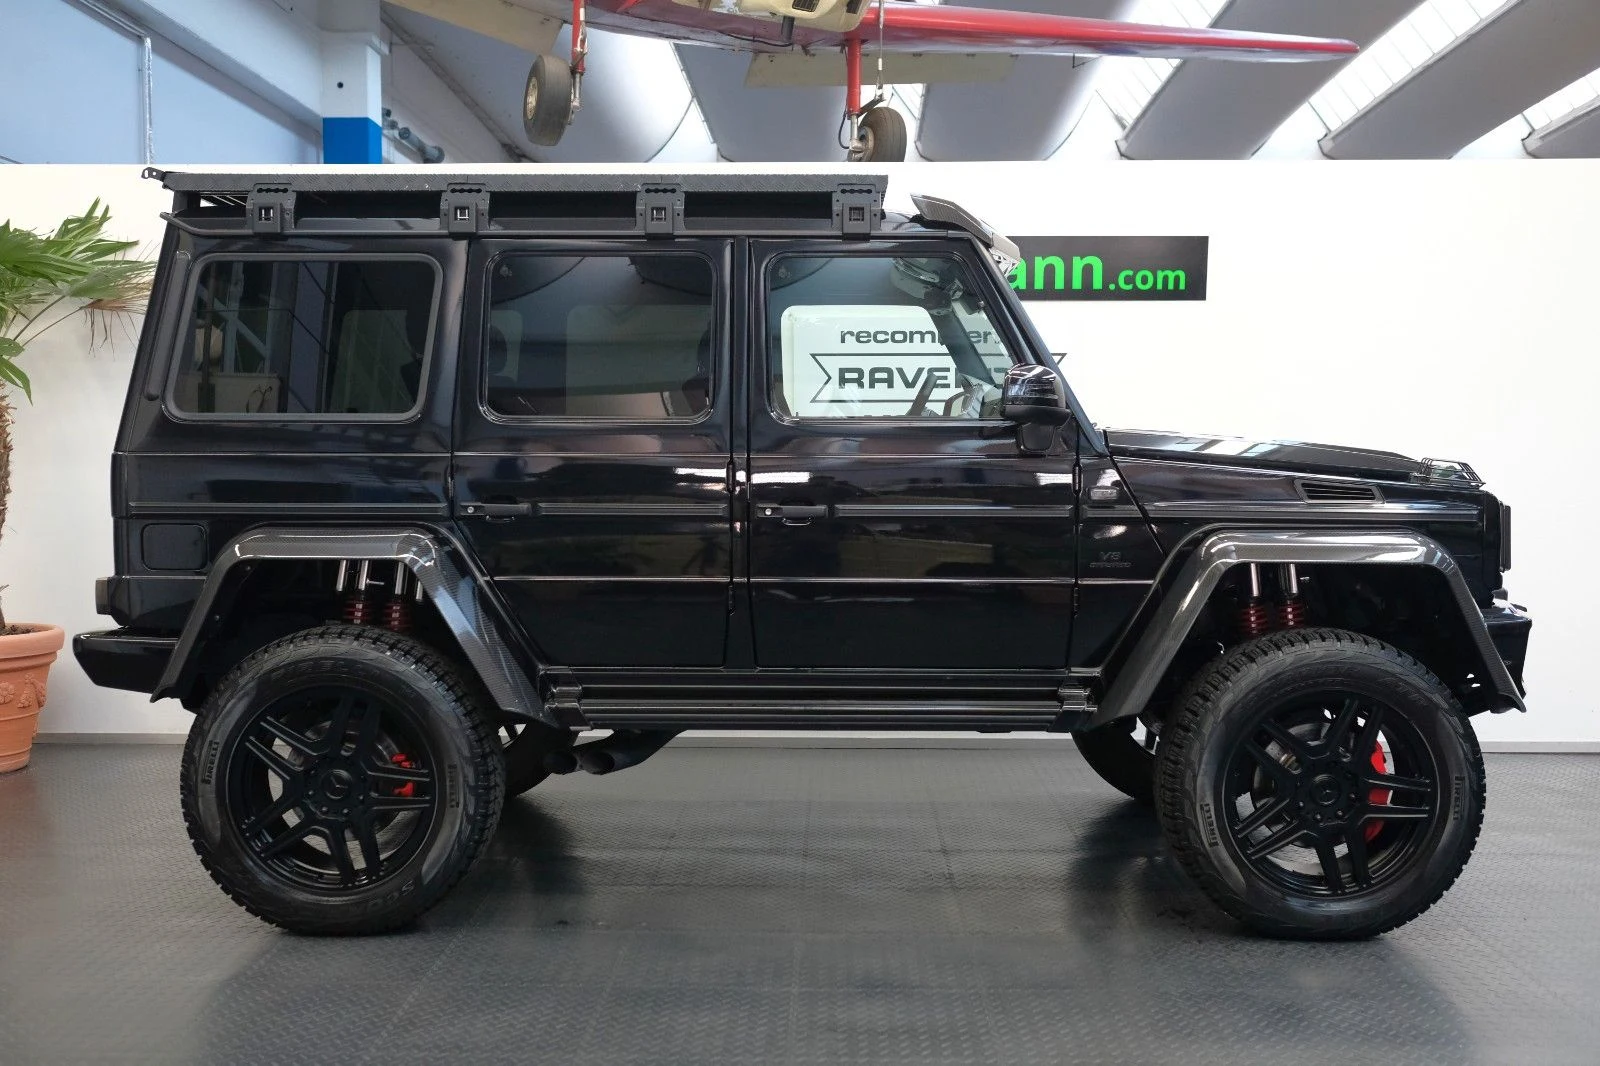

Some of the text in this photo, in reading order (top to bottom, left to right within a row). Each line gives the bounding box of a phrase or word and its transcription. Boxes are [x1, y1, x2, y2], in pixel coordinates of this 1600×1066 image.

[201, 739, 220, 785] PIRELLI
[1453, 775, 1466, 821] PIRELLI
[1200, 803, 1219, 848] PIRELLI
